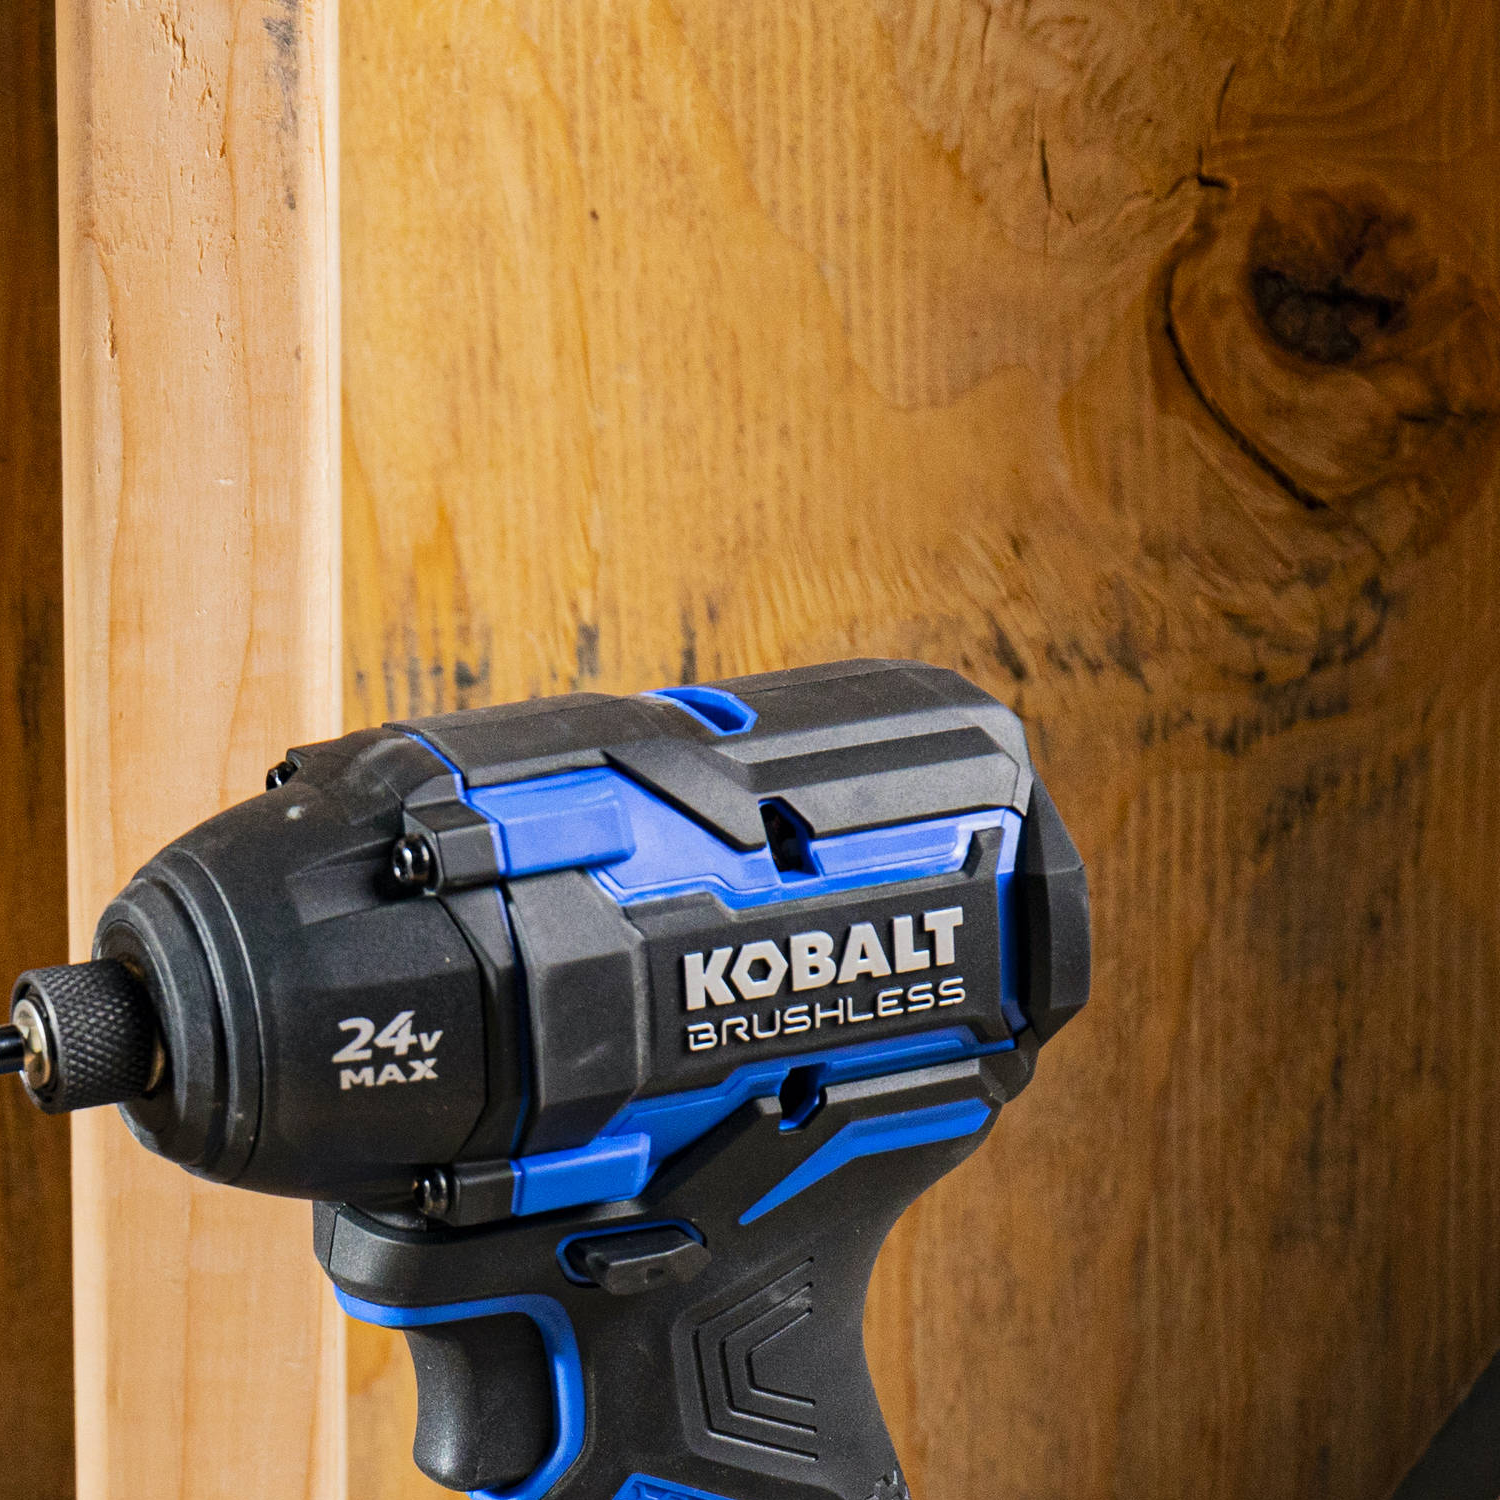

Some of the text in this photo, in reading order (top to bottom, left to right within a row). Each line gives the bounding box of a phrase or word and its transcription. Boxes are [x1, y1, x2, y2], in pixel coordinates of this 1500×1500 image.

[684, 905, 964, 1011] KOBALT
[688, 978, 966, 1052] BRUSHLESS
[340, 1057, 439, 1091] MAX
